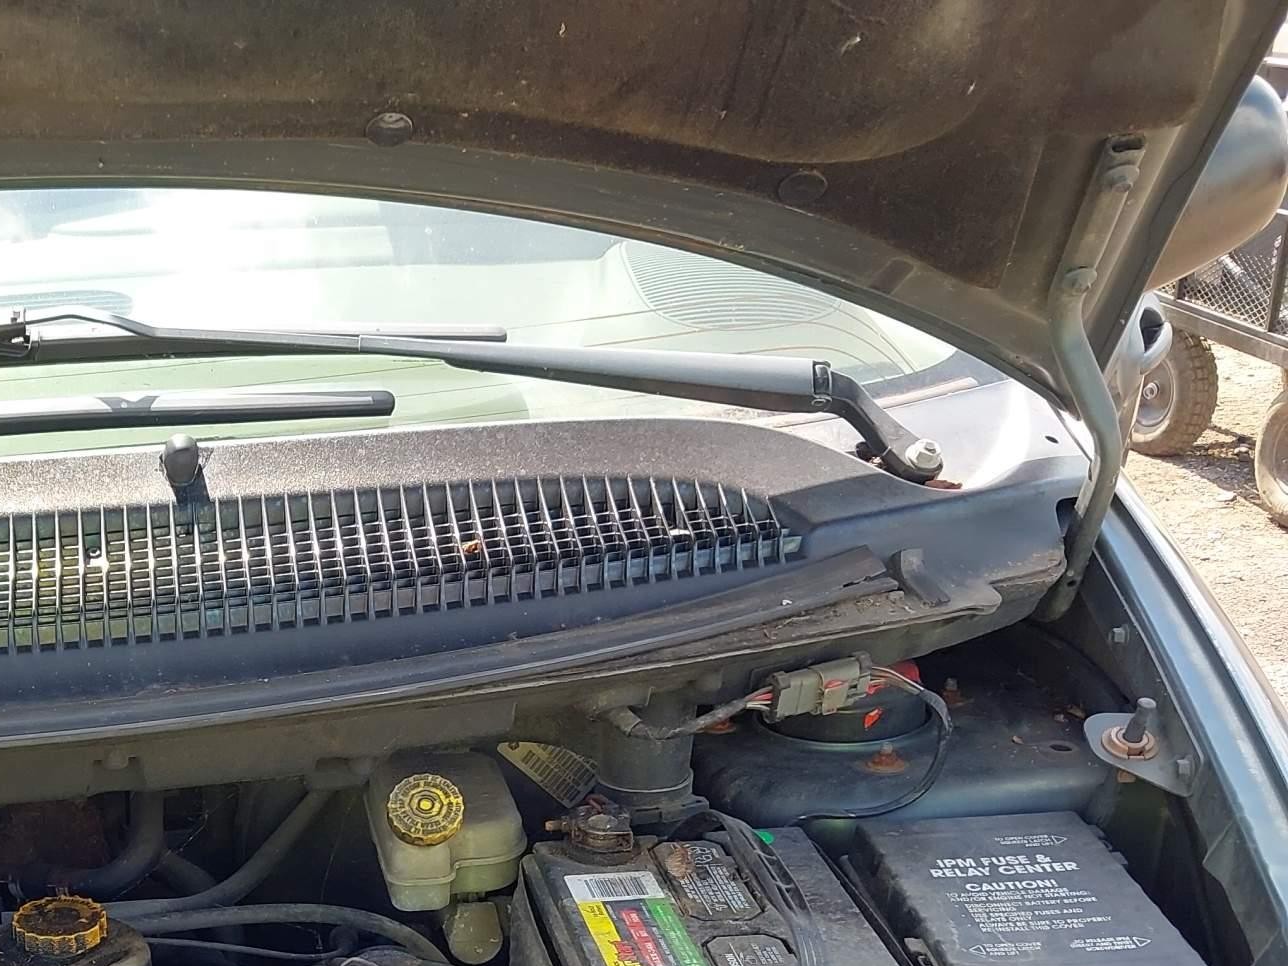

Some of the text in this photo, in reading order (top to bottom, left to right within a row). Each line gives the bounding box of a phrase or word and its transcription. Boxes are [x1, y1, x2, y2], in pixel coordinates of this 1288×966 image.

[980, 855, 1030, 866] FUSE
[1035, 854, 1052, 863] &
[929, 862, 1080, 878] RELAY CENTER
[965, 879, 1059, 891] CAUTION!
